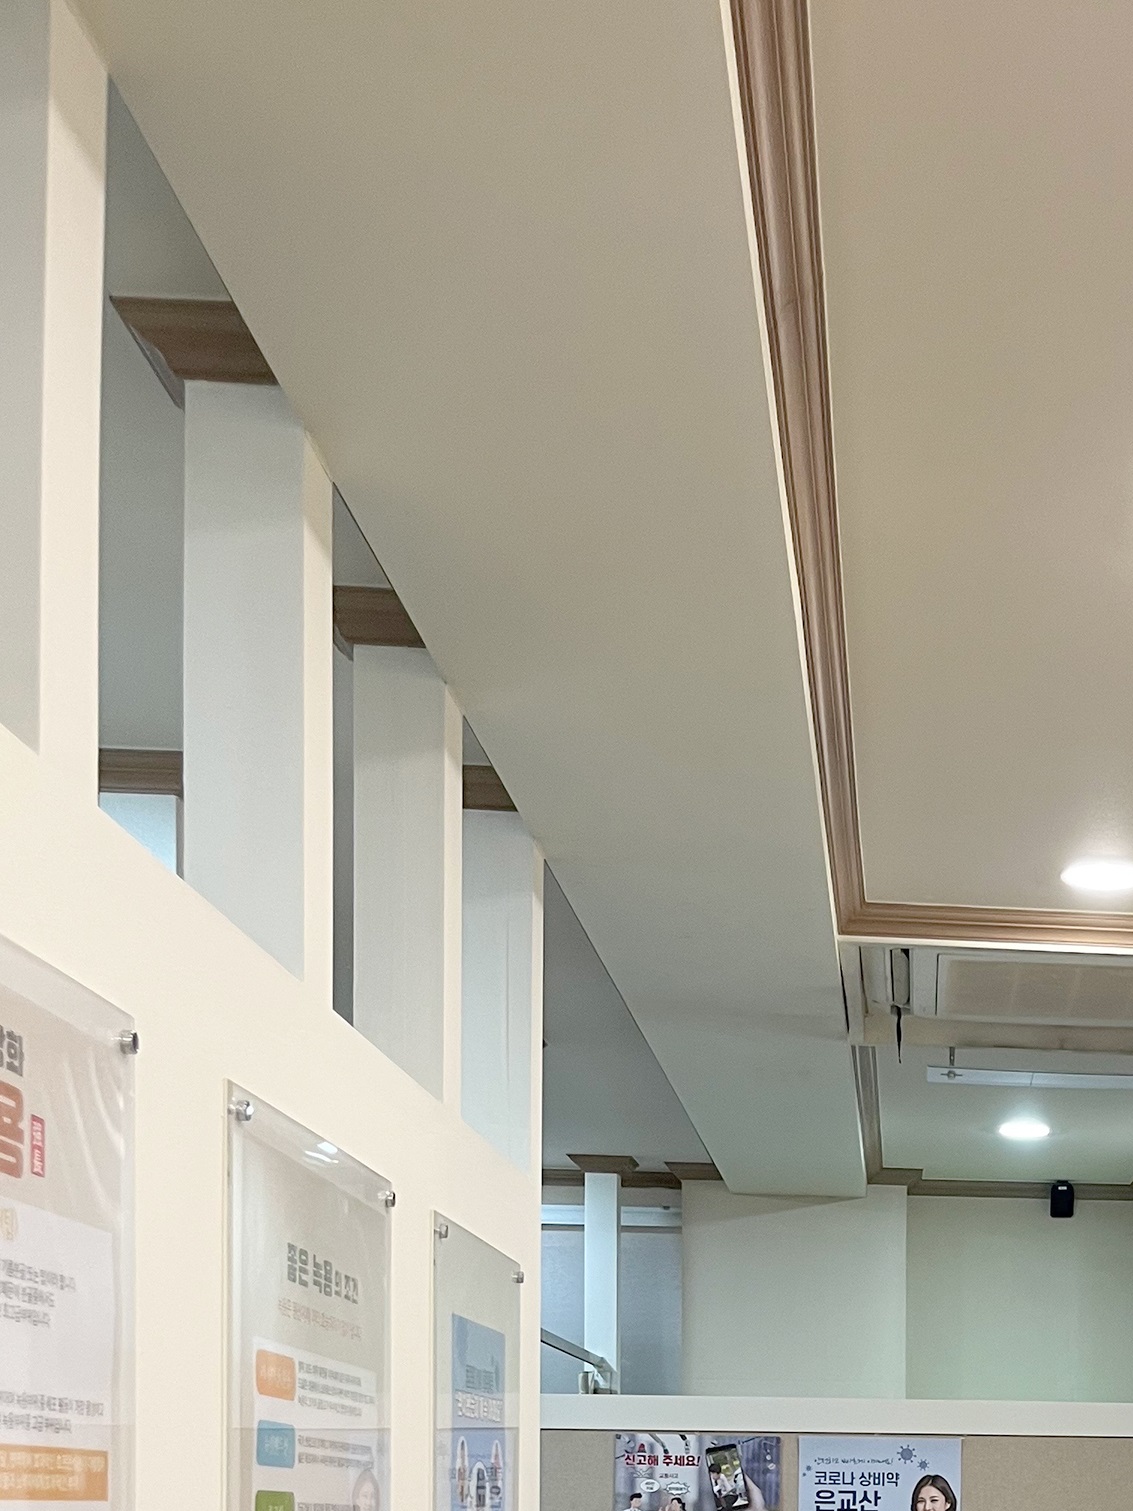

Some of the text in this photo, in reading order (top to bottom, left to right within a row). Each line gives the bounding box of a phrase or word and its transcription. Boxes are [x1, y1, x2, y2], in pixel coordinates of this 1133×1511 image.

[287, 1242, 309, 1288] 좋은
[344, 1274, 359, 1304] 조건
[624, 1454, 701, 1467] 신고해 주세요!
[814, 1471, 900, 1487] 코로나 상비약
